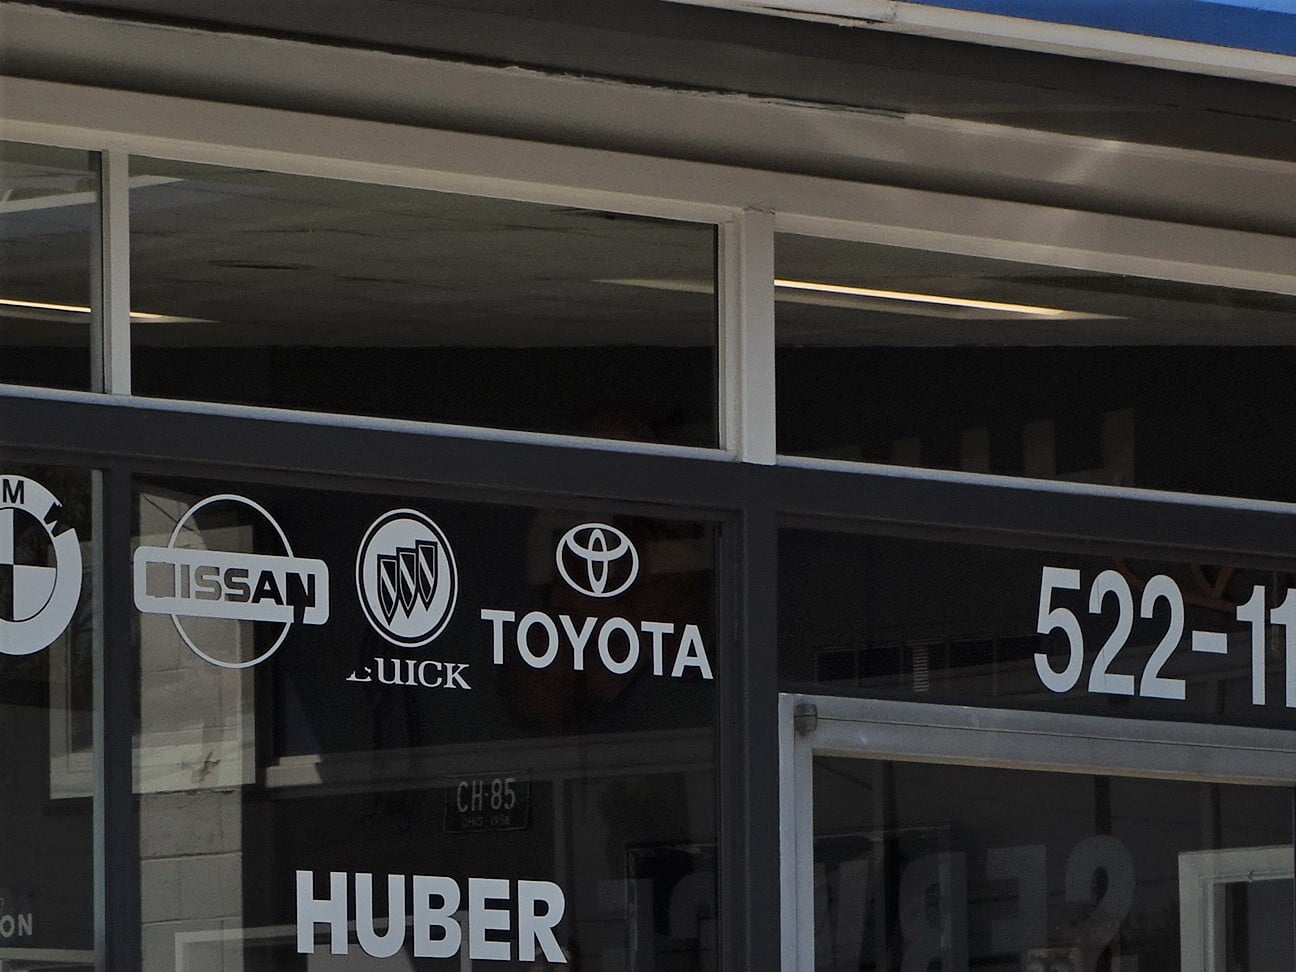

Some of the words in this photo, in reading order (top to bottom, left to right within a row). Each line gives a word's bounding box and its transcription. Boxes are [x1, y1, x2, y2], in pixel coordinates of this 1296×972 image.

[146, 560, 316, 608] ISSAN
[480, 609, 714, 680] TOYOTA
[296, 869, 568, 964] HUBER
